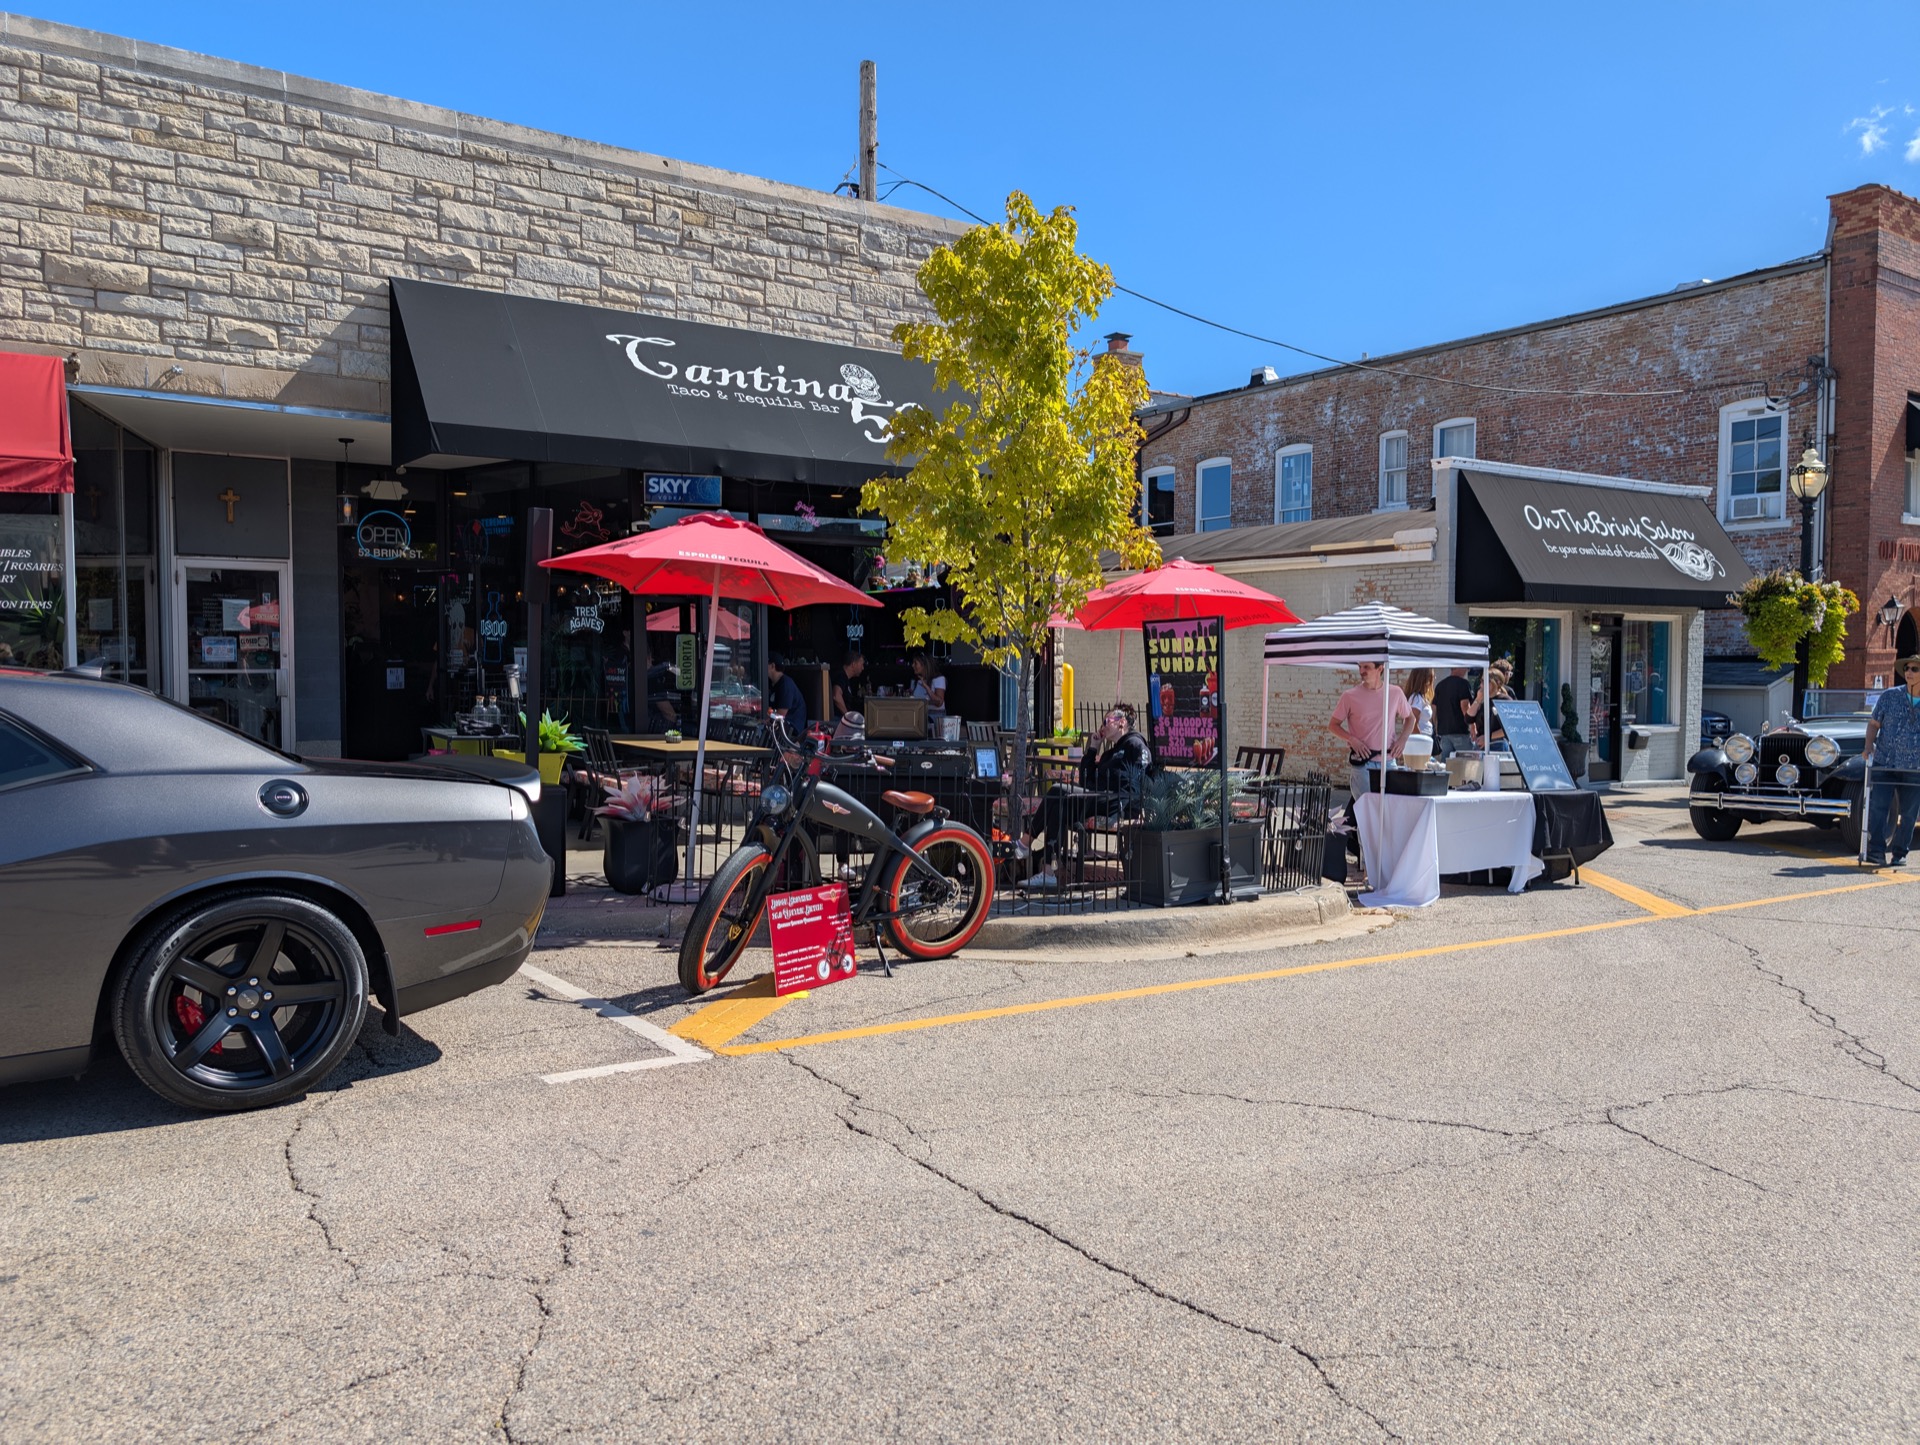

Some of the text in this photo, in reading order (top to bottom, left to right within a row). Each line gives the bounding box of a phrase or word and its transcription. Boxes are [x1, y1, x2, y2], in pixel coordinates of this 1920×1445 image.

[605, 334, 852, 402] Cantina
[667, 383, 840, 414] Taco & Tequila Bar
[648, 477, 691, 494] SKYY
[360, 525, 408, 544] OPEN
[358, 548, 424, 559] 52 BRINK ST.
[1542, 538, 1559, 553] be
[1559, 545, 1577, 559] your
[1579, 547, 1597, 556] own
[728, 556, 770, 567] TEQUILA
[19, 600, 53, 609] ITEMS
[575, 605, 596, 617] TRES
[1148, 635, 1218, 655] SUNDAY
[1150, 655, 1218, 674] FUNDAY
[1158, 716, 1214, 729] $6 BLOODYS
[1153, 726, 1218, 739] $5 MICHELADA
[1168, 735, 1186, 747] $20
[1158, 746, 1194, 758] FLIGHTS
